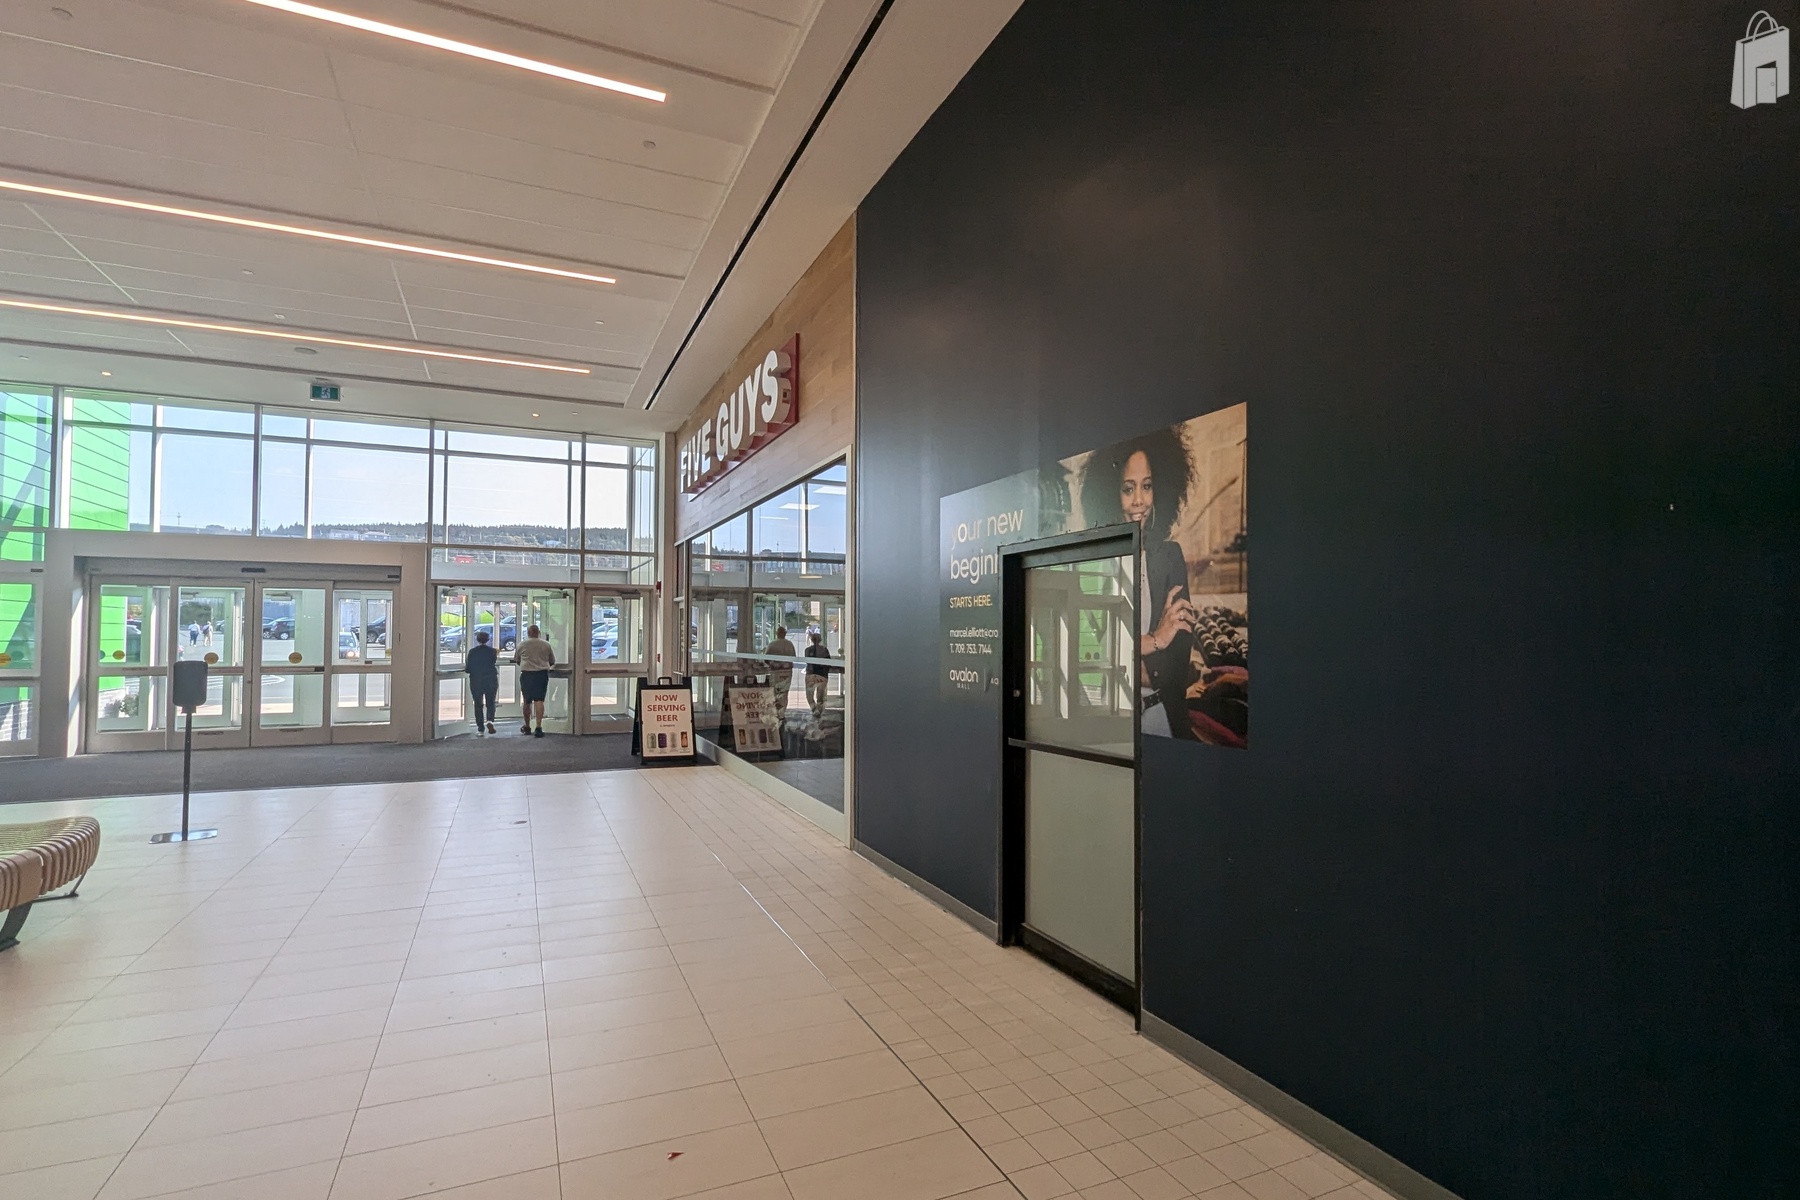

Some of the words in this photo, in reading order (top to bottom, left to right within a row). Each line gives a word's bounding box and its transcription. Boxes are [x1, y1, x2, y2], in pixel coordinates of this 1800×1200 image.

[680, 418, 711, 494] FIVE
[715, 349, 779, 462] GUYS
[951, 519, 983, 551] your
[987, 509, 1023, 536] new
[949, 595, 972, 609] STARTS
[973, 594, 993, 607] HERE.
[949, 666, 979, 683] avalon
[654, 694, 678, 702] NOW
[647, 704, 686, 712] SERVING
[656, 714, 679, 722] BEER
